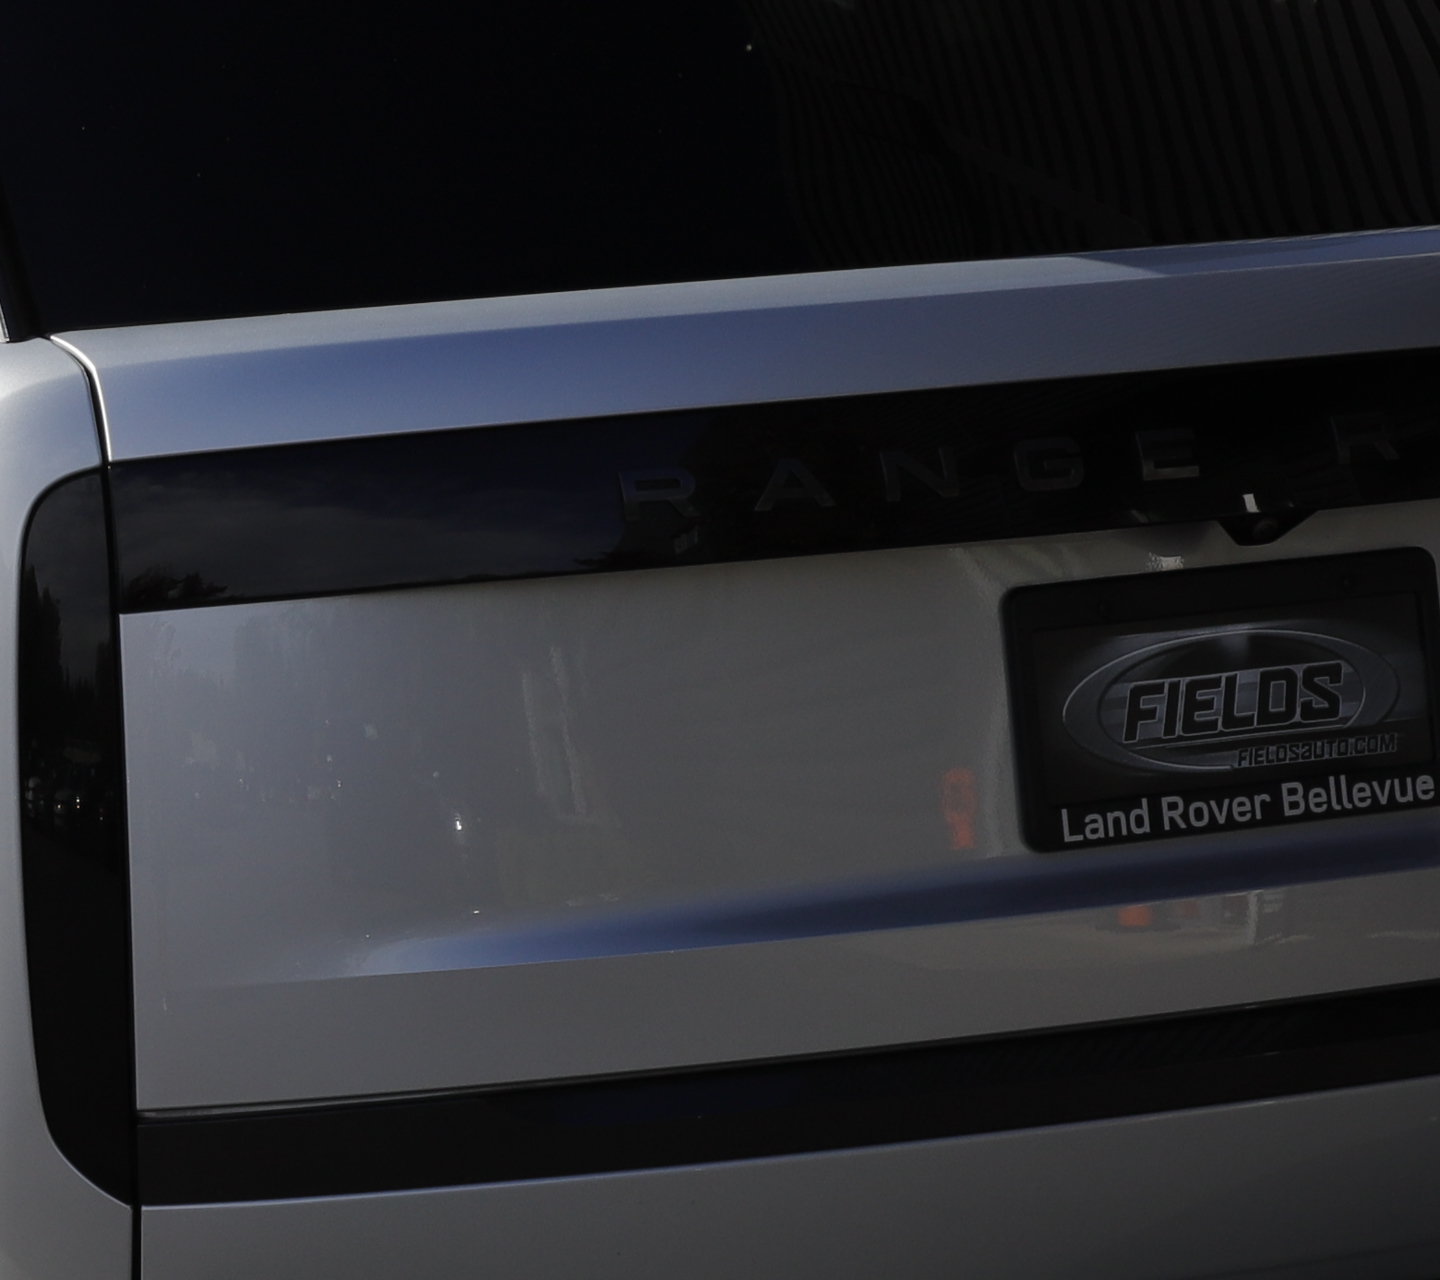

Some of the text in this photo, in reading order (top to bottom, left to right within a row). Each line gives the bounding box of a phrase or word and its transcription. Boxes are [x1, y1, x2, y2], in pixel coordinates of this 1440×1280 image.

[619, 427, 1201, 521] RANGE
[1121, 659, 1344, 744] FIELDS
[1060, 773, 1436, 843] Land Rover Bellevue
